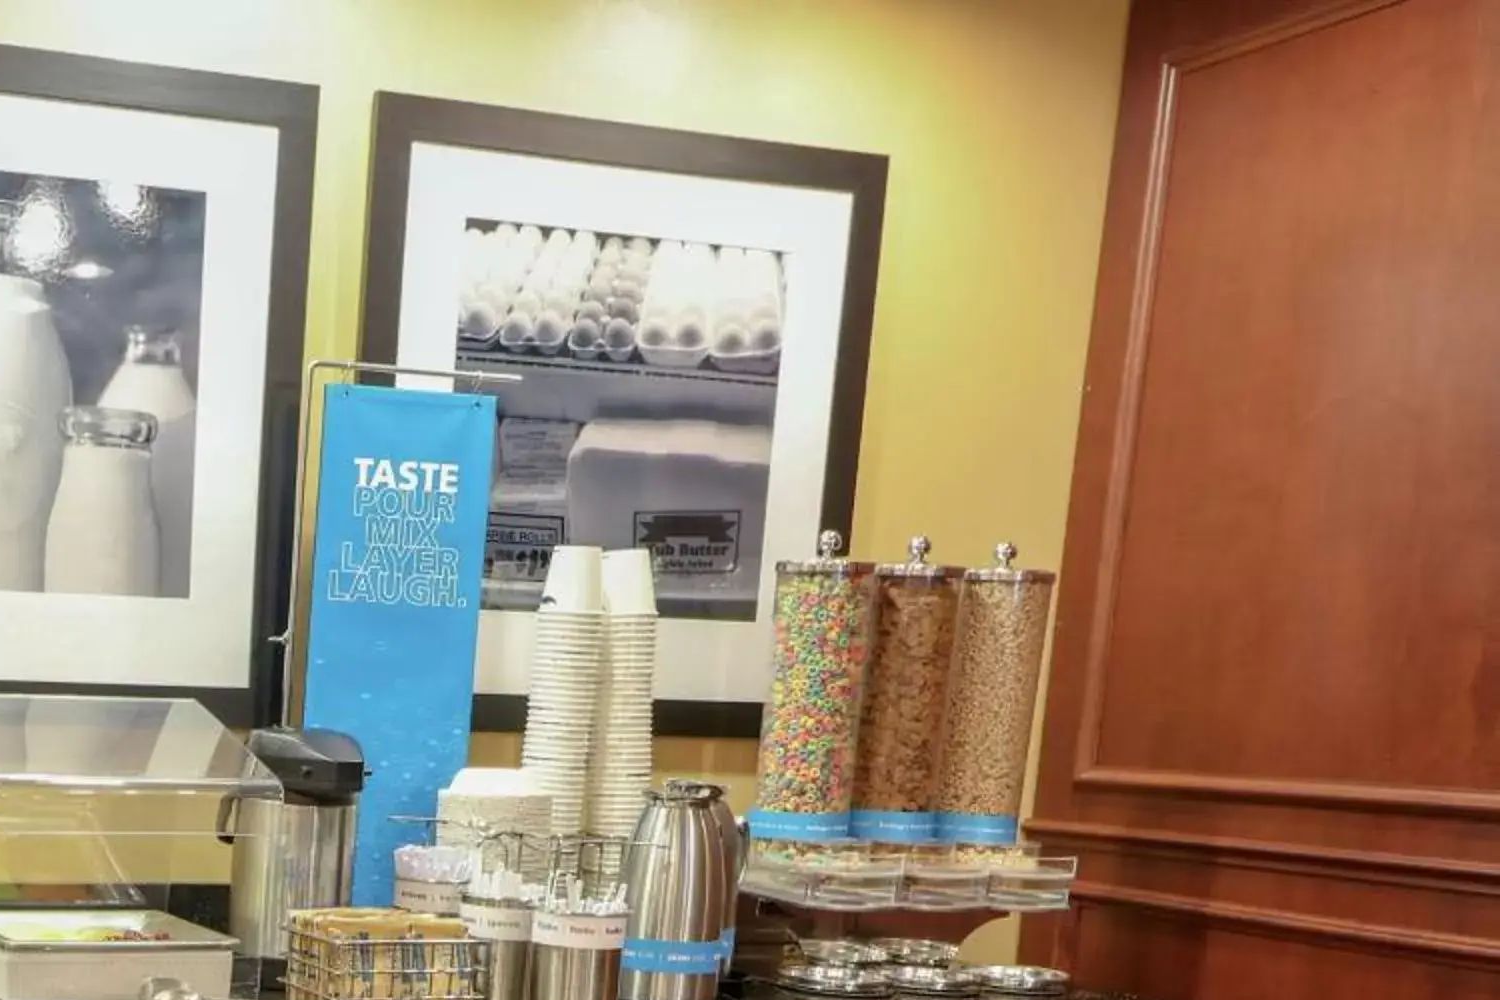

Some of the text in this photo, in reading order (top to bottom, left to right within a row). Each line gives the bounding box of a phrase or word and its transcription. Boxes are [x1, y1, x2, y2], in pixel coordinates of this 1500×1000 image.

[353, 457, 459, 493] TASTE
[353, 485, 455, 524] POUR
[365, 514, 440, 549] MIX
[342, 541, 459, 578] LAYER
[679, 543, 729, 557] Butter
[327, 569, 467, 608] LAUGH.
